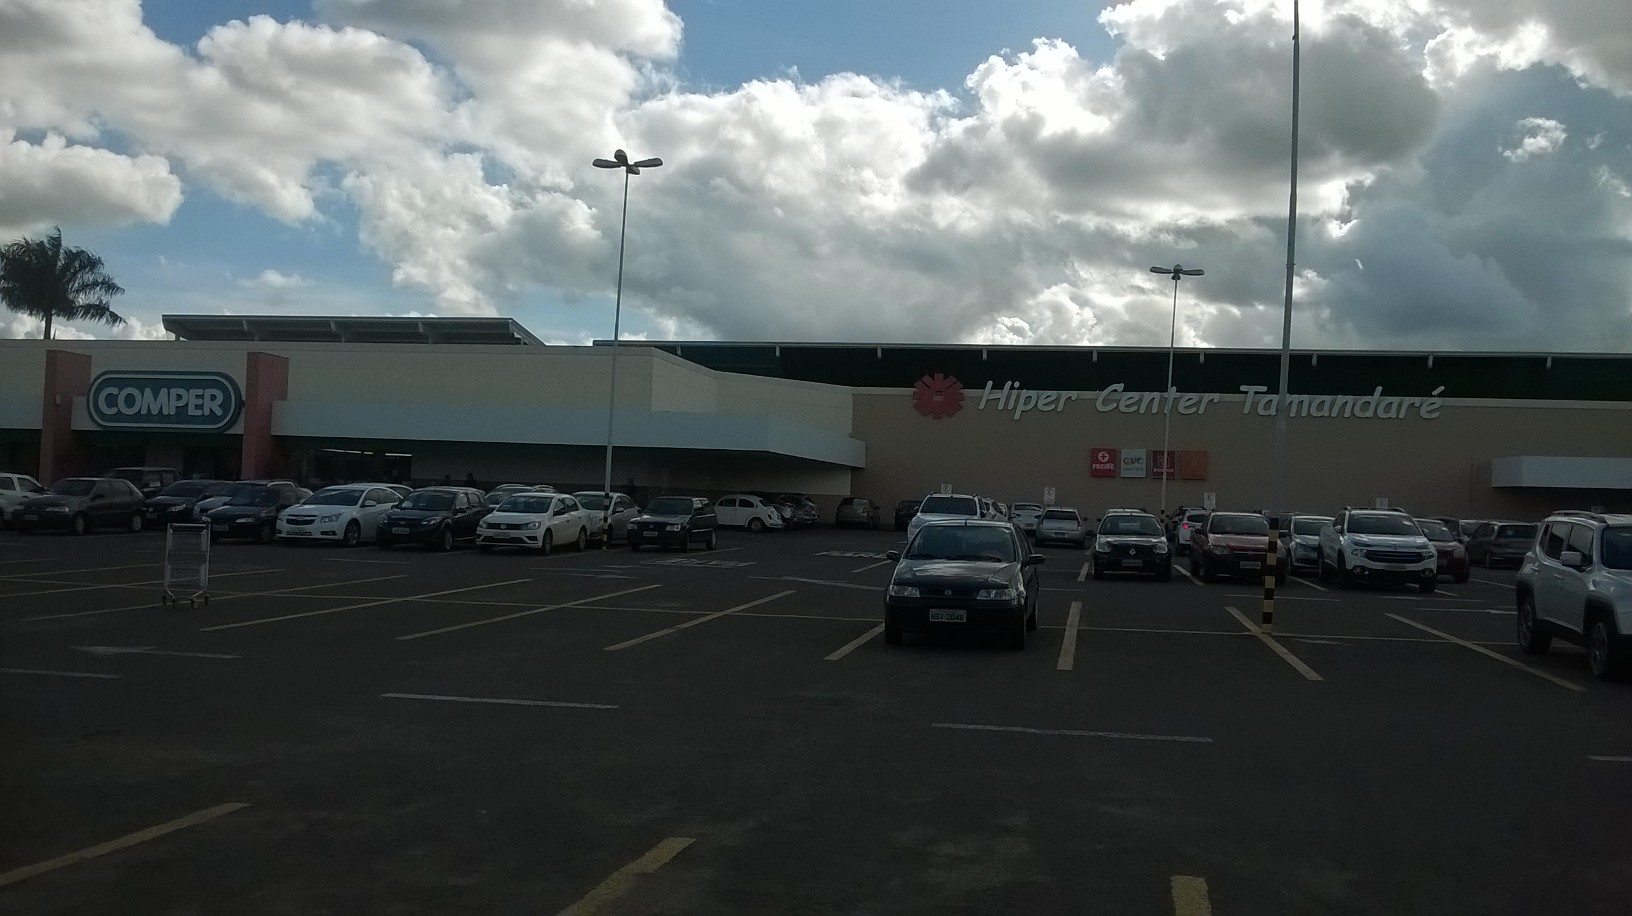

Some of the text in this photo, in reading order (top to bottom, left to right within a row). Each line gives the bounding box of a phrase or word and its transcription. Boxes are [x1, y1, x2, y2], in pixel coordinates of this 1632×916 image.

[98, 387, 223, 416] COMPER
[978, 380, 1445, 420] Hiper Center Tamandaré
